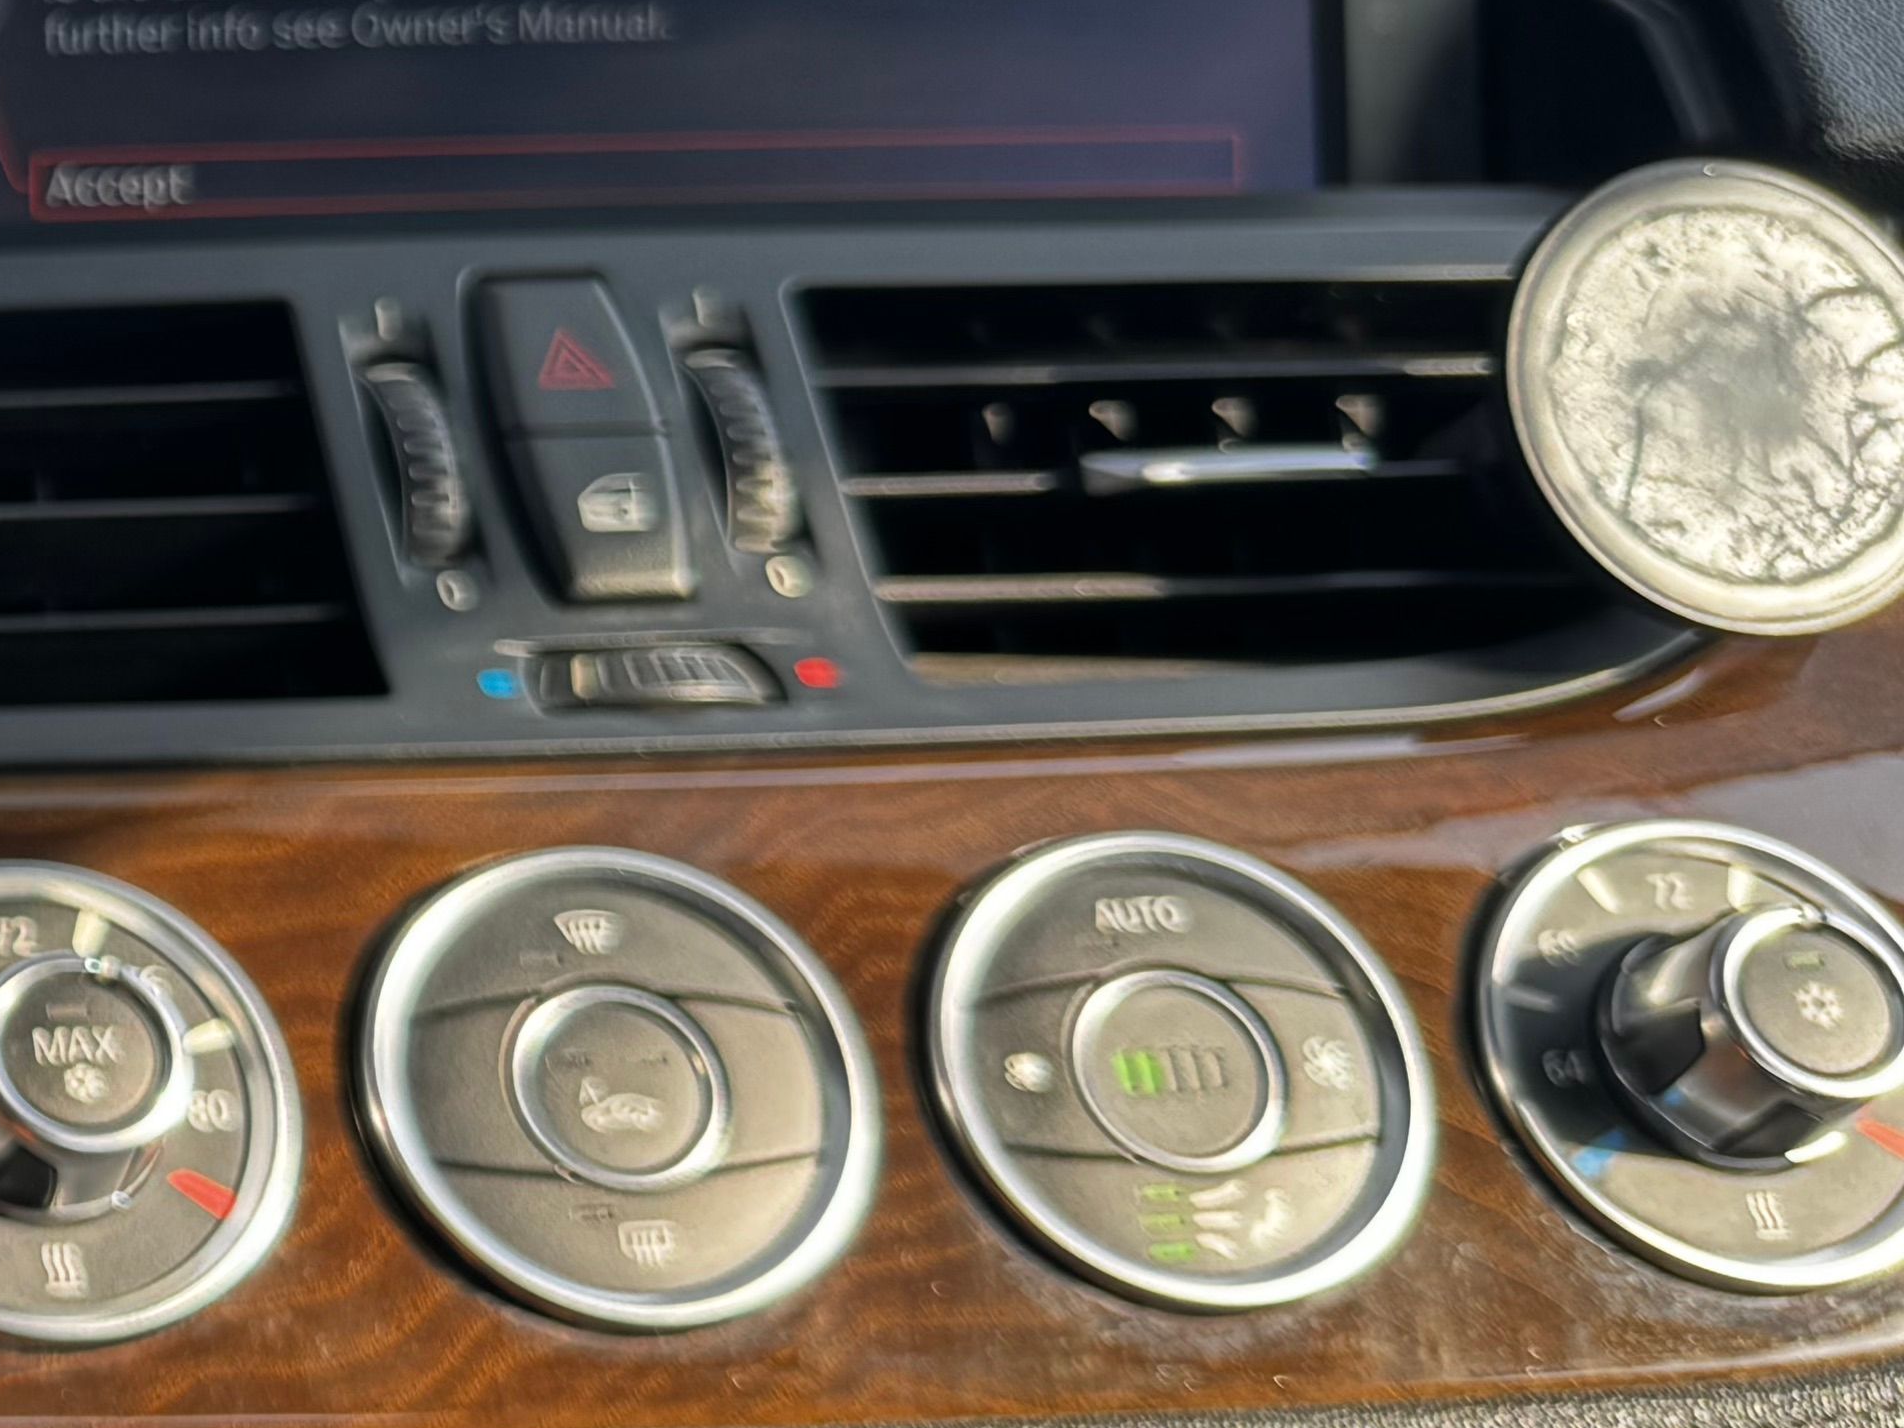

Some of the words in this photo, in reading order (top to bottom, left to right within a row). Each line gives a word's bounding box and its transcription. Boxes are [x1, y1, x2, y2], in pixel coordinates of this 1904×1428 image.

[45, 10, 184, 56] further
[187, 9, 271, 51] info
[273, 11, 353, 50] see
[352, 3, 513, 49] Owner's
[46, 162, 193, 213] Accept
[1645, 871, 1692, 910] 72
[1095, 895, 1190, 933] AUTO
[30, 1025, 121, 1067] MAX
[187, 1089, 239, 1133] 80
